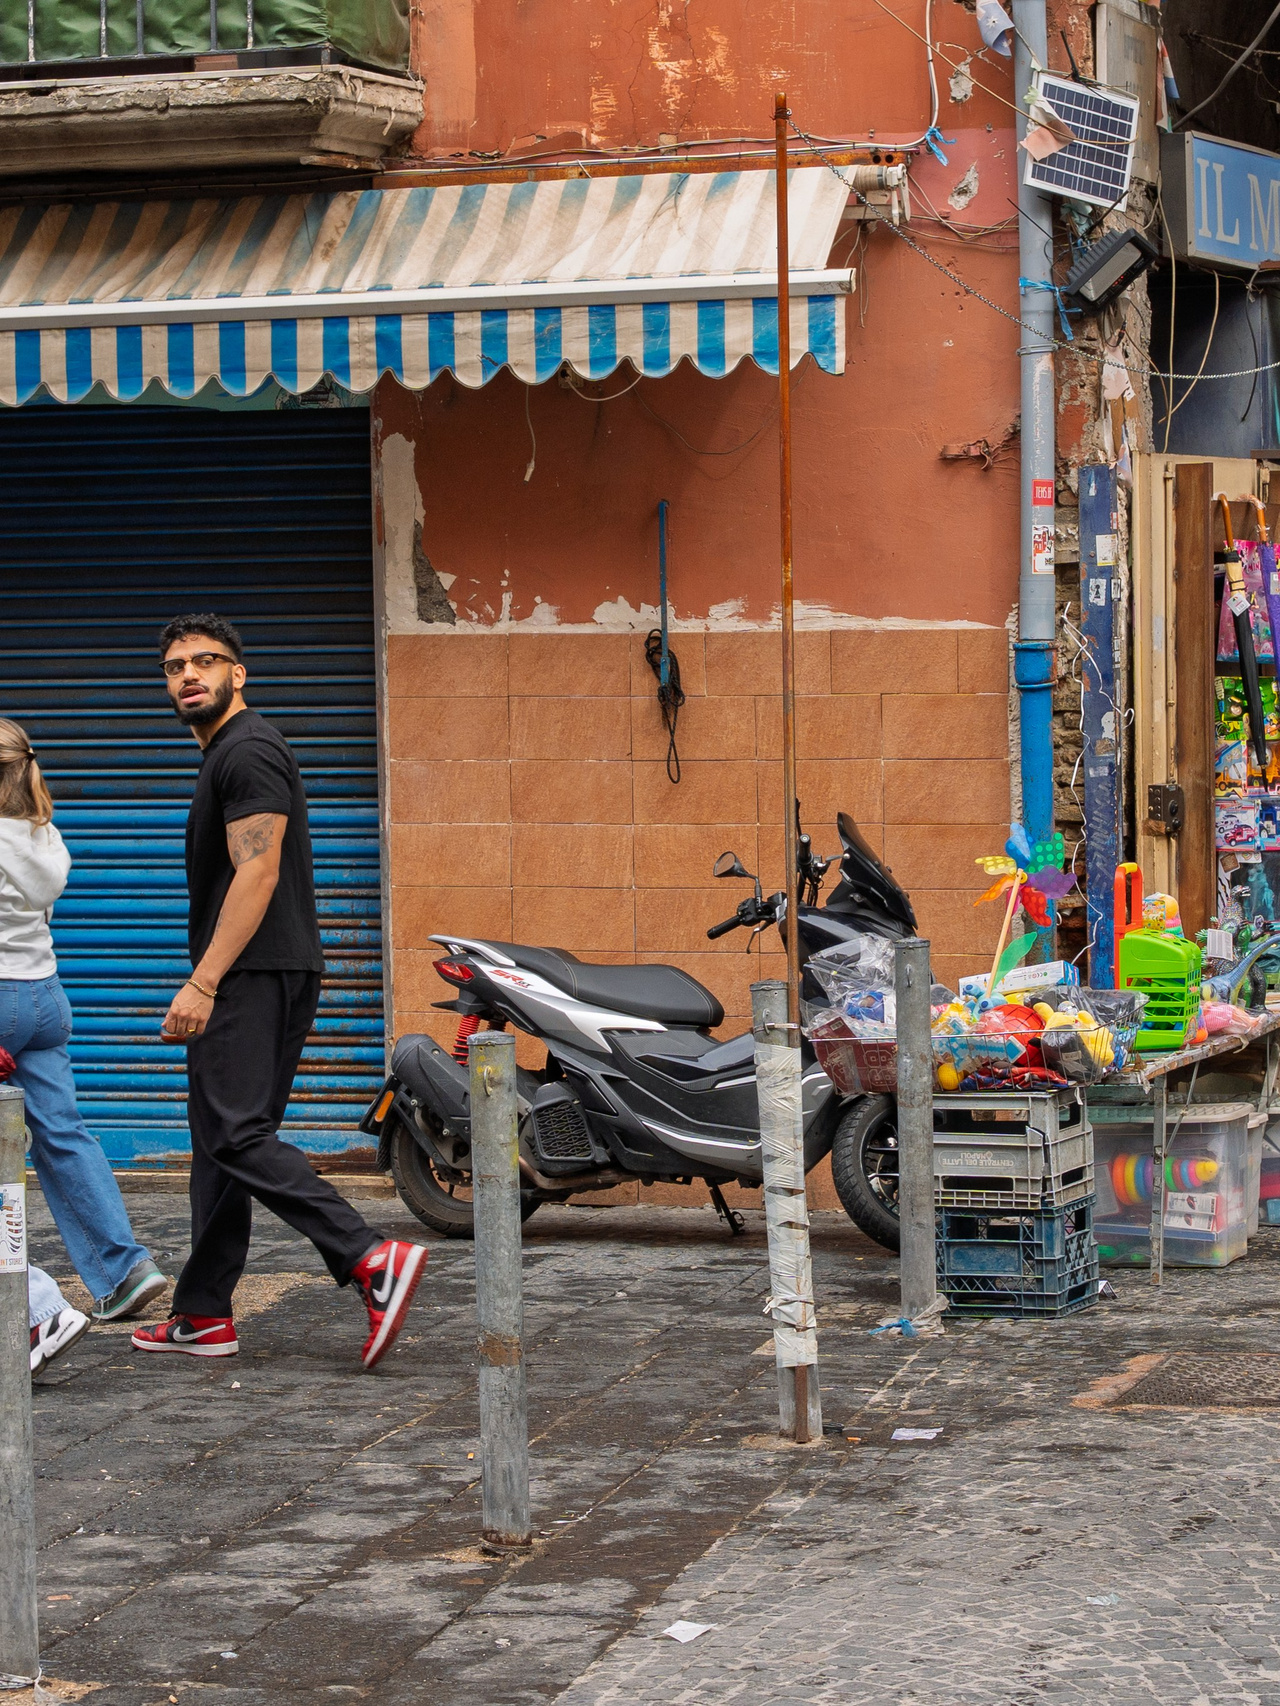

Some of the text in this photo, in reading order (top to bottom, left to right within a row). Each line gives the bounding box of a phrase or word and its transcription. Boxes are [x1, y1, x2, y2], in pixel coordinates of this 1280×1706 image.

[1197, 158, 1240, 245] IL
[961, 1152, 986, 1160] NAPOLI
[942, 1158, 1014, 1167] CENTRALE DEL LATTE
